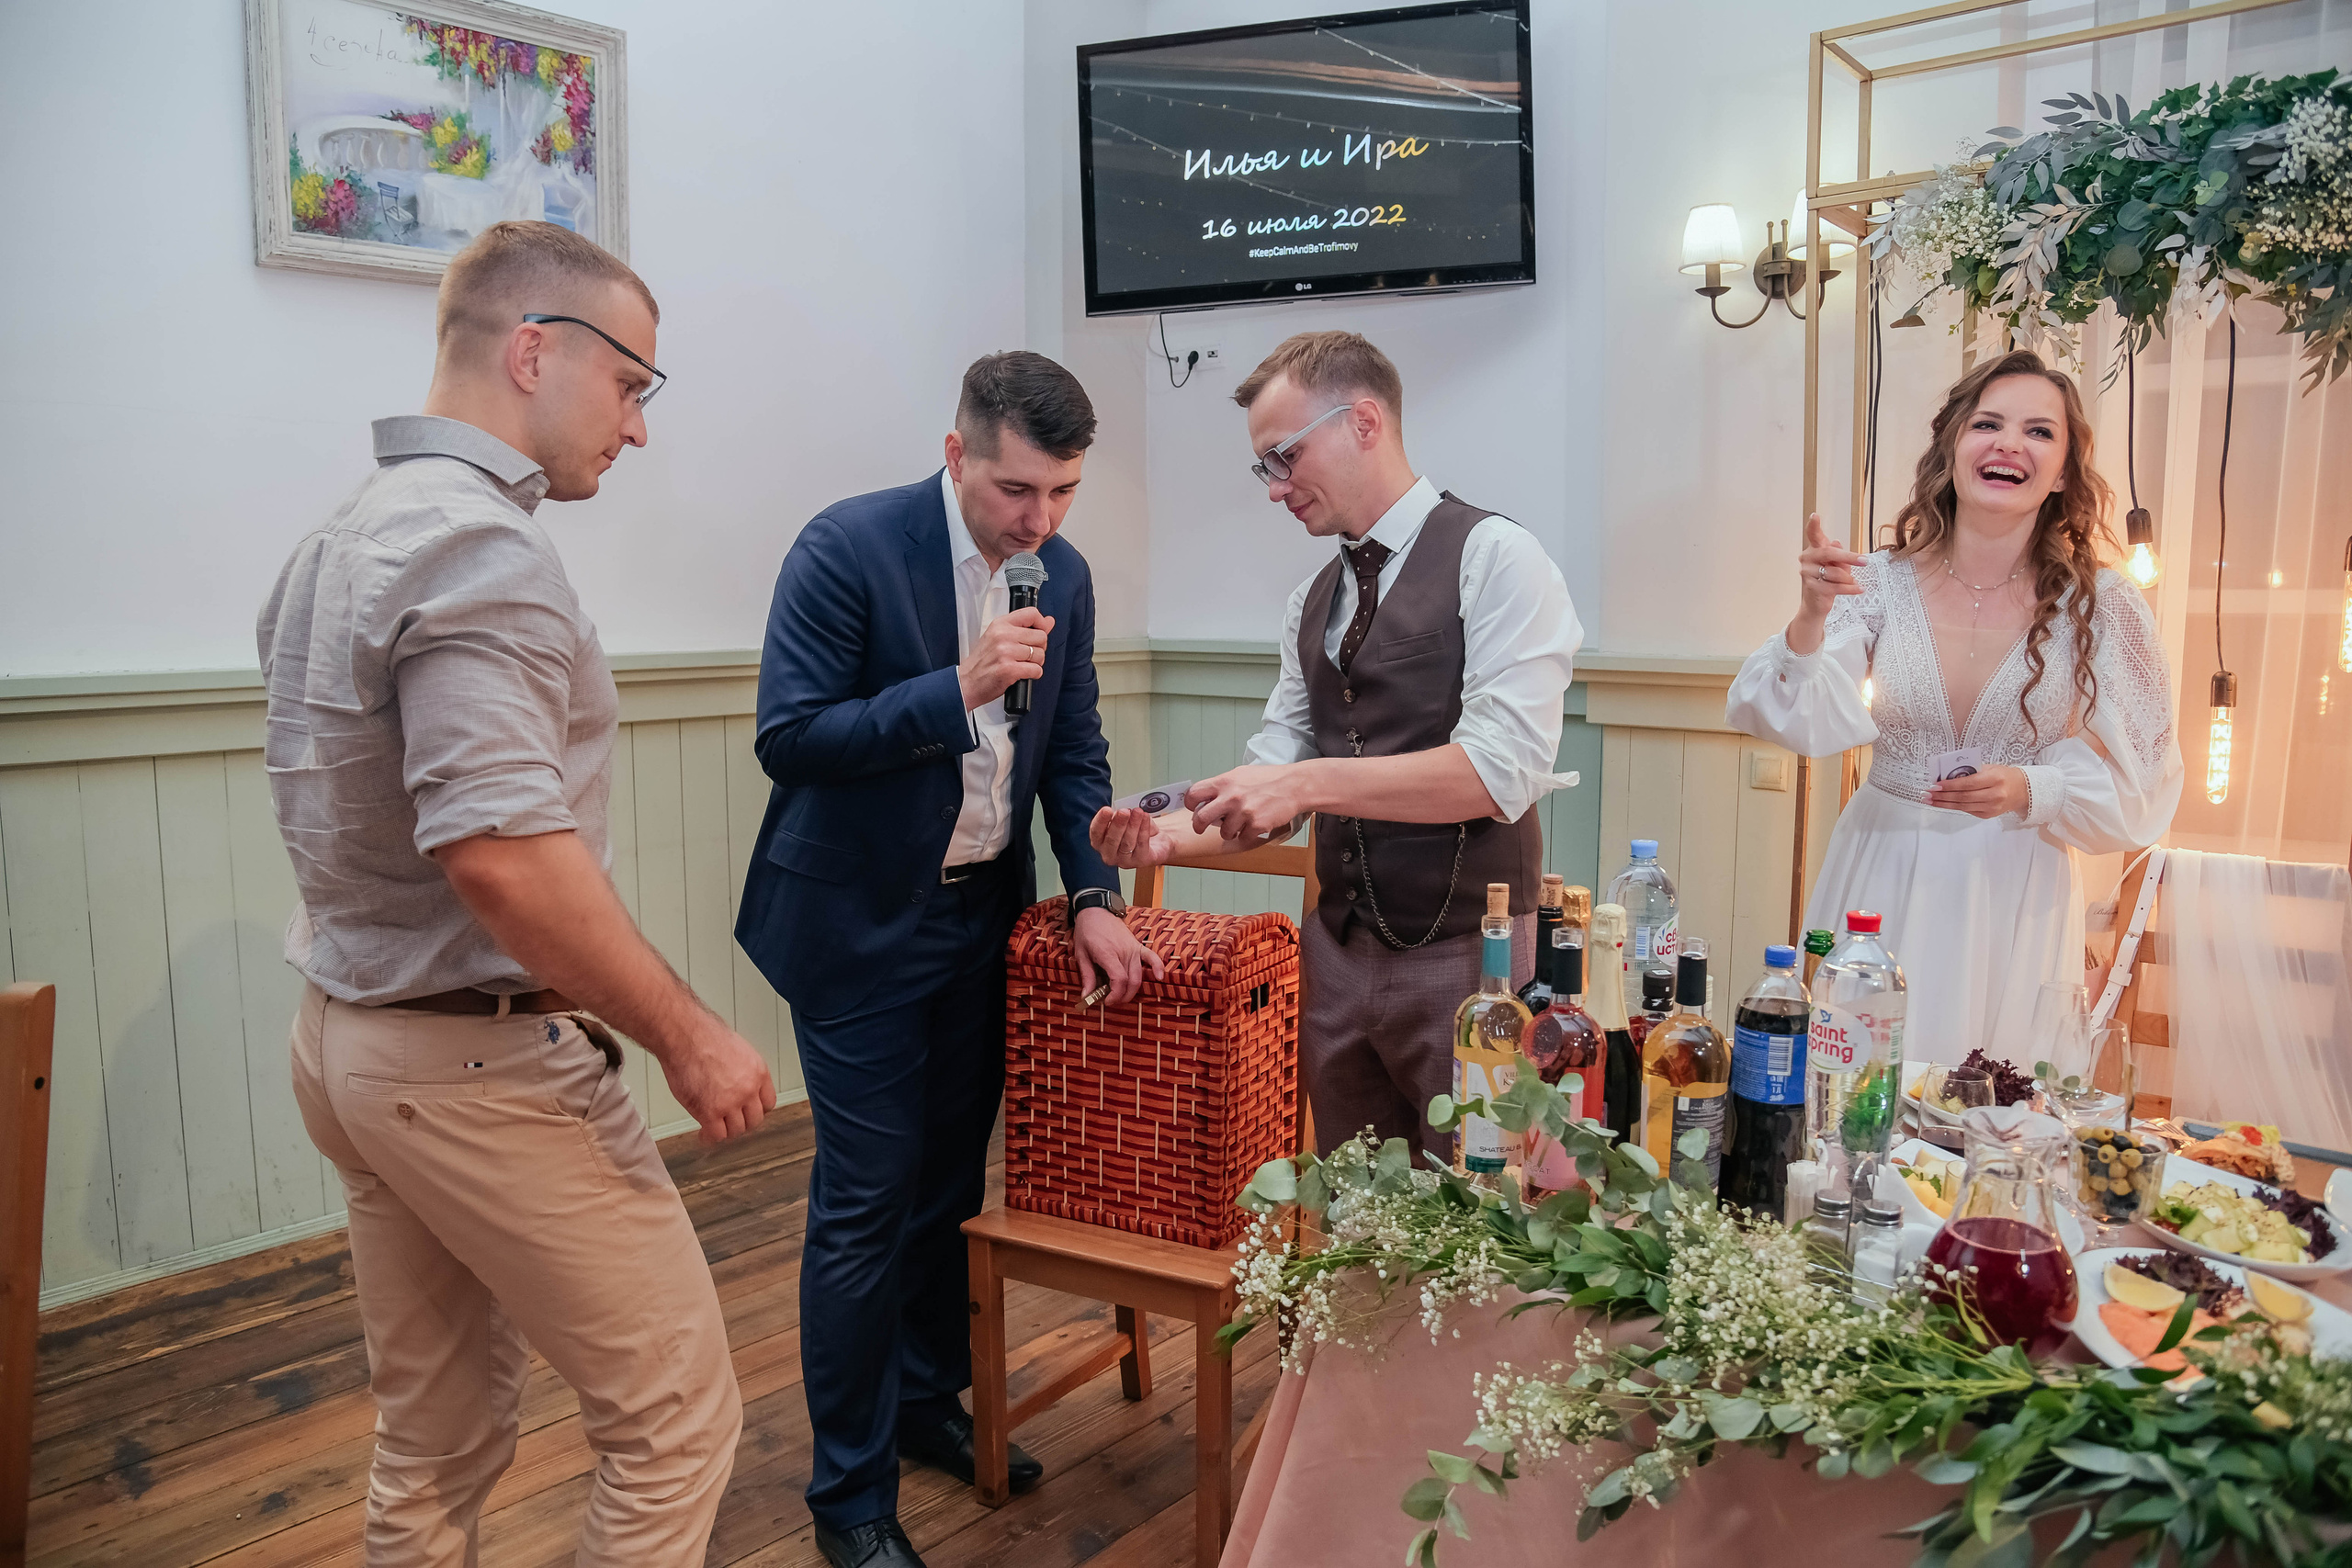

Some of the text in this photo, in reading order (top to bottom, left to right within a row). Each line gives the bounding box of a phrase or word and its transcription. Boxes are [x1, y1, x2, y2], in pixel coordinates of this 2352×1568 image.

[1183, 133, 1430, 181] Илья и Ира
[1202, 204, 1407, 240] 16 июля 2022
[1249, 242, 1359, 258] #KeepCalmAndBeTrofimovy
[1811, 1021, 1849, 1043] saint
[1479, 1145, 1515, 1153] SHATEAU
